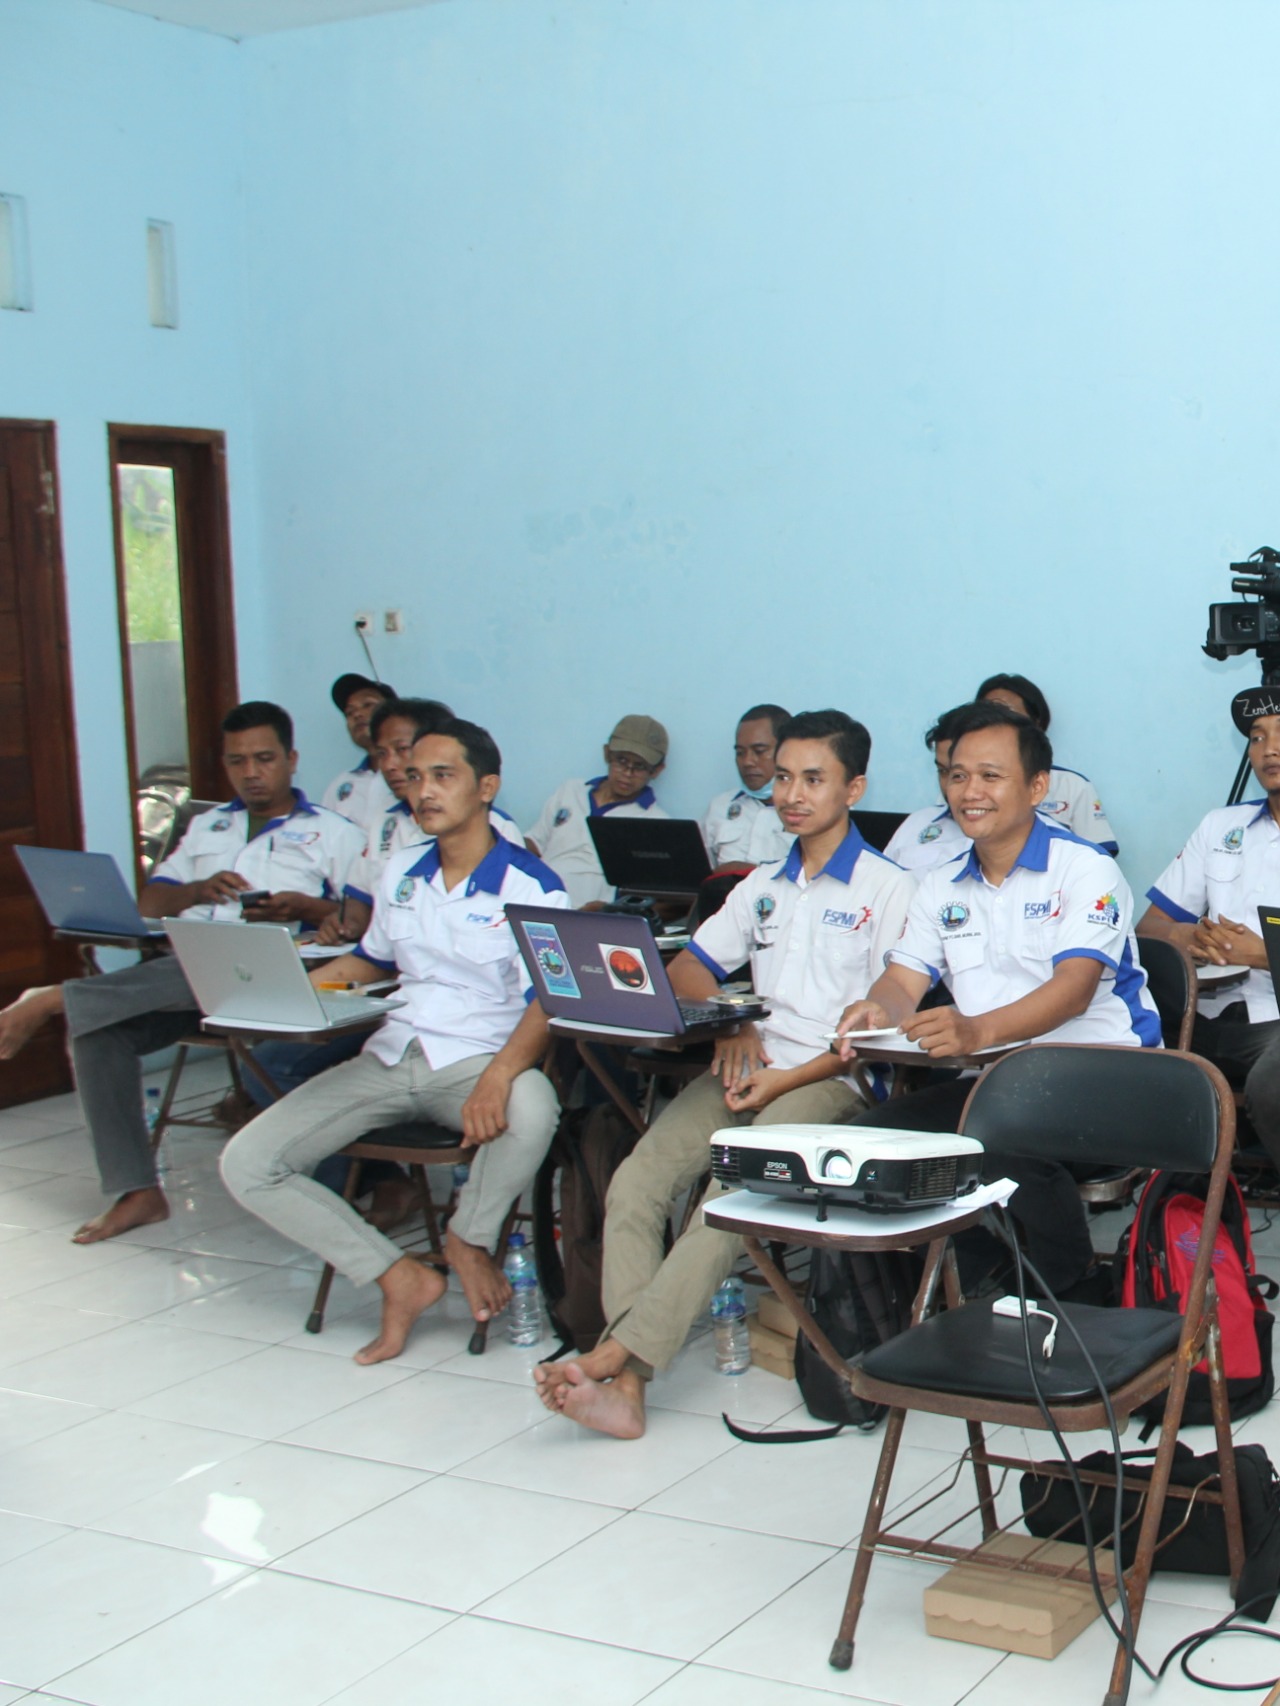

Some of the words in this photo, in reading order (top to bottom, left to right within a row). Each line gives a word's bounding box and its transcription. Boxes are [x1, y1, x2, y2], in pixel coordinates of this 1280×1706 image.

[1024, 899, 1052, 917] FSPMI
[822, 908, 858, 927] FSPMI
[766, 1161, 788, 1170] EPSON
